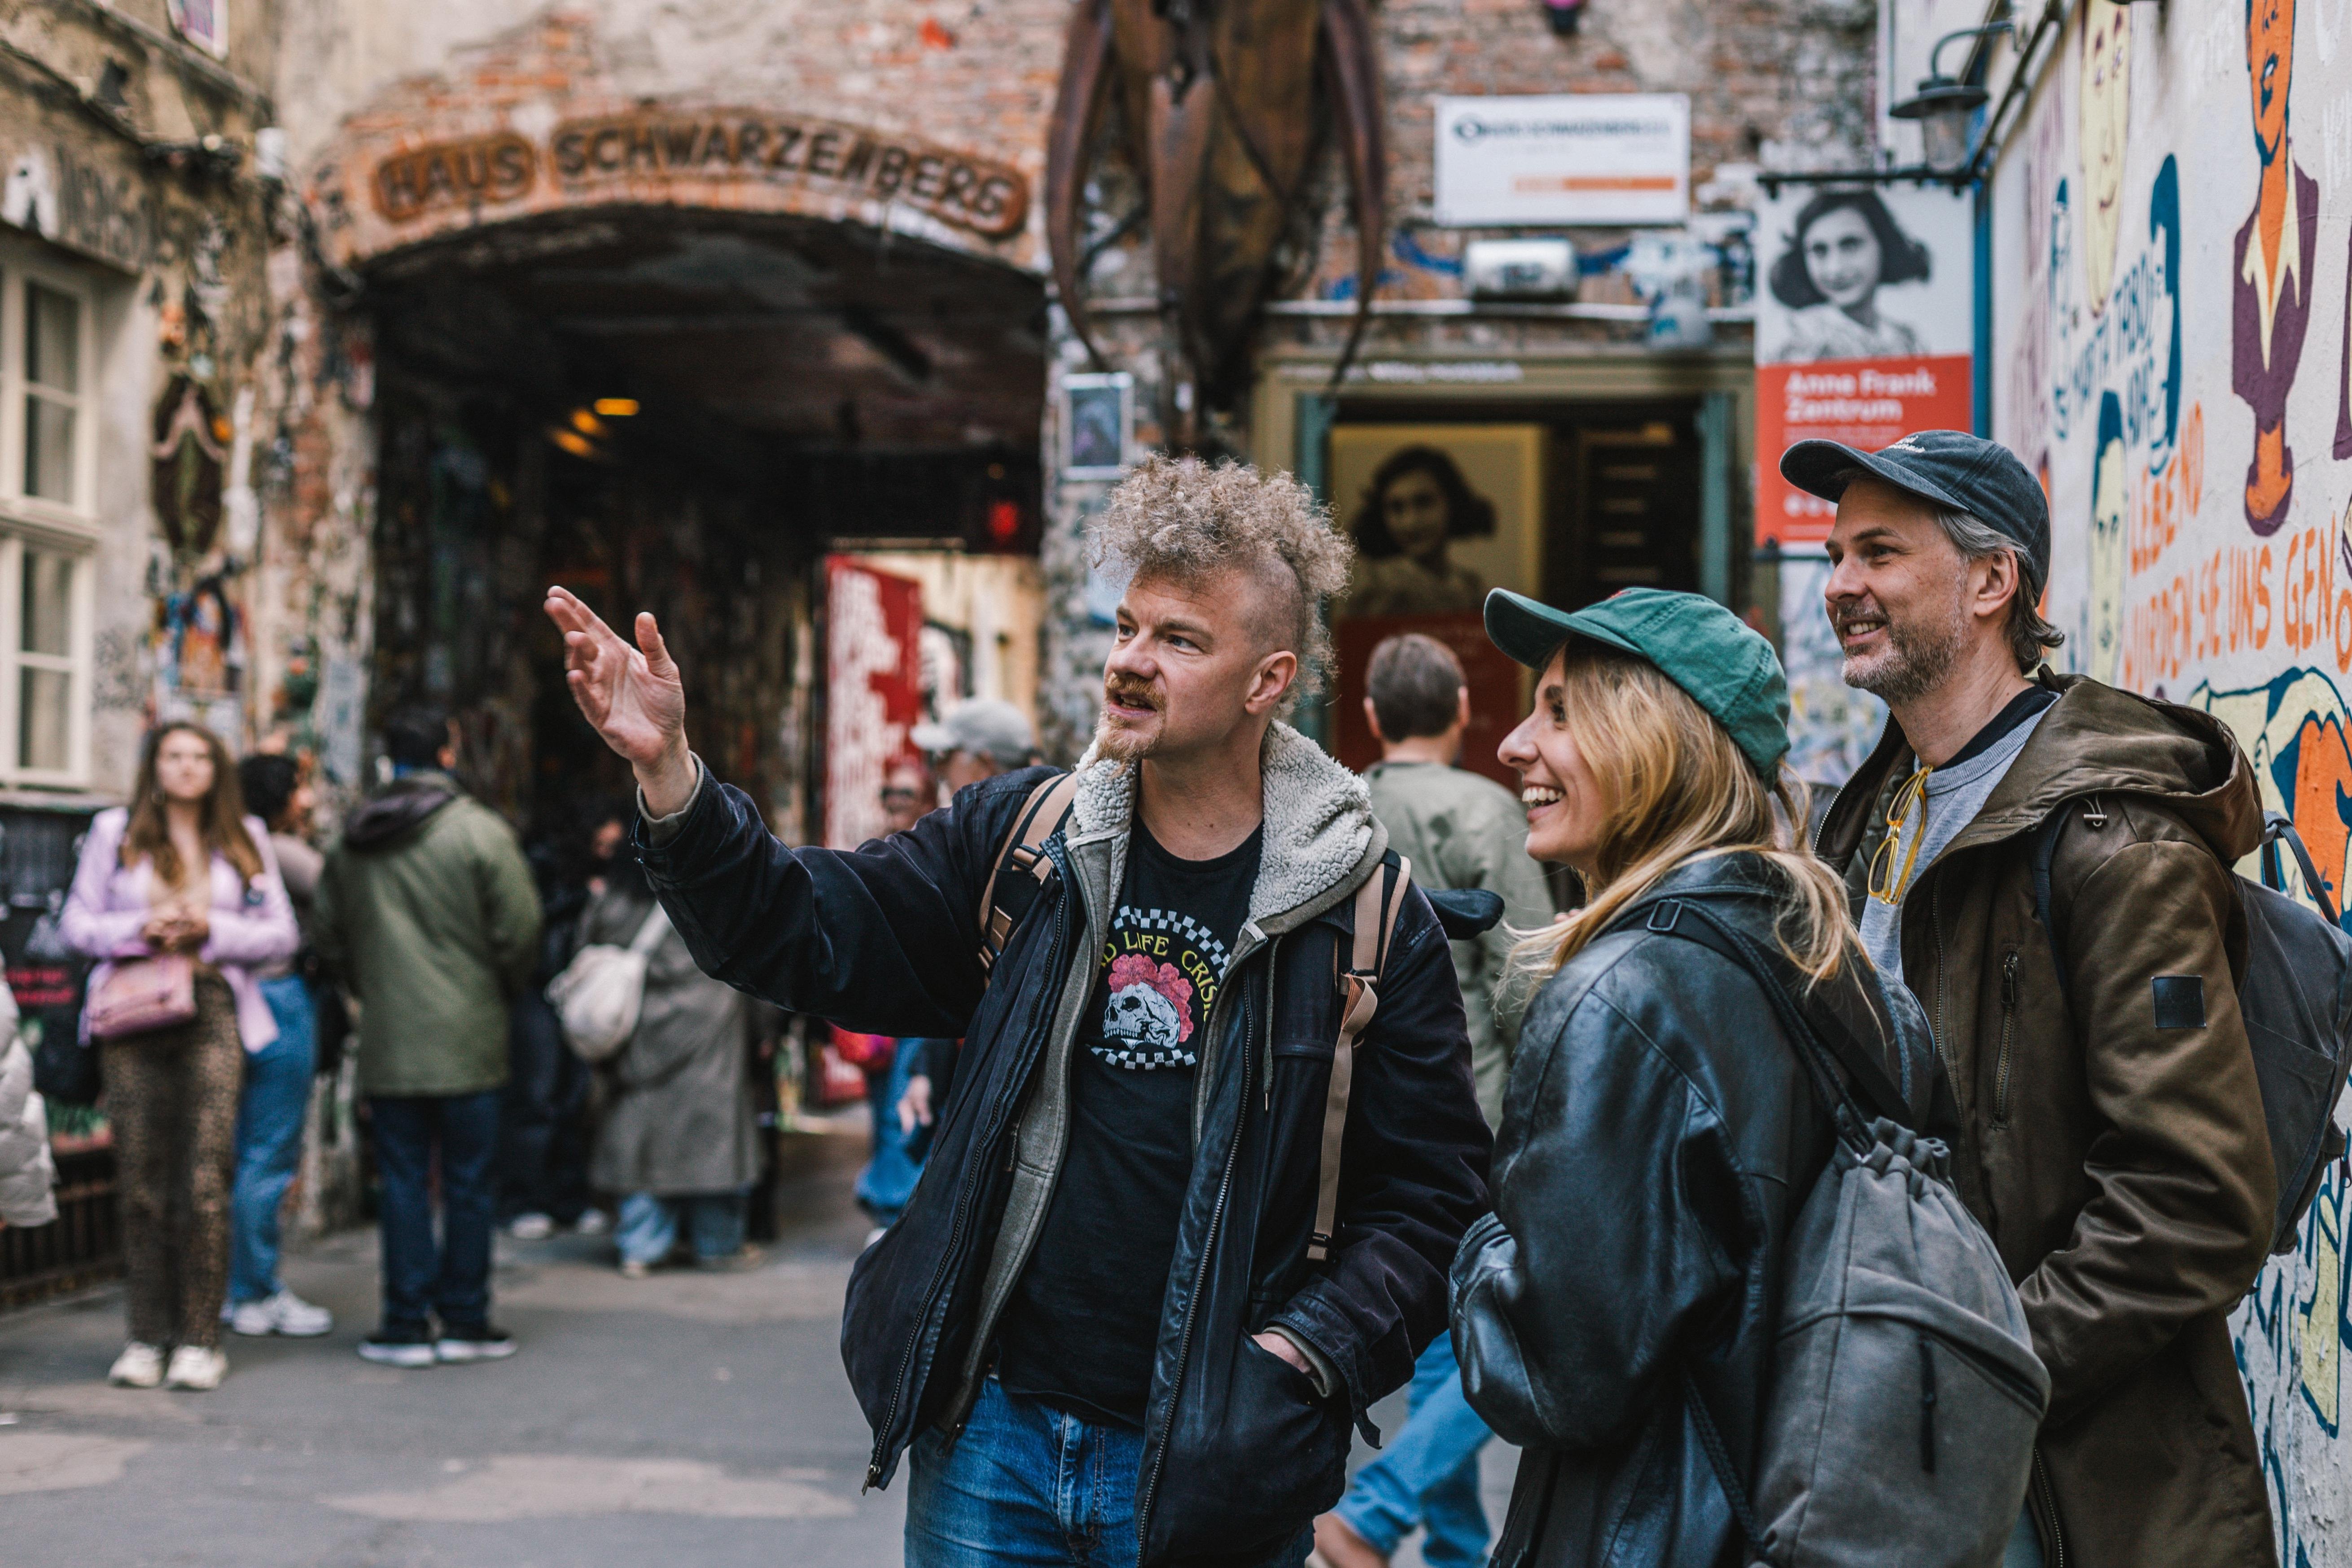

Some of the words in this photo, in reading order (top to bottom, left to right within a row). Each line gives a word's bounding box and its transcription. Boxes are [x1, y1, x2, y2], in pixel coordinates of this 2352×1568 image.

[384, 143, 526, 208] HAUS
[557, 122, 1015, 219] SCHWARZENBERG
[1786, 371, 1856, 396] Anne
[1860, 367, 1936, 396] Frank
[1786, 397, 1902, 422] Zentrum
[2228, 545, 2272, 651] UNS
[1124, 931, 1169, 956] LIFE
[1182, 950, 1217, 1022] CRIS
